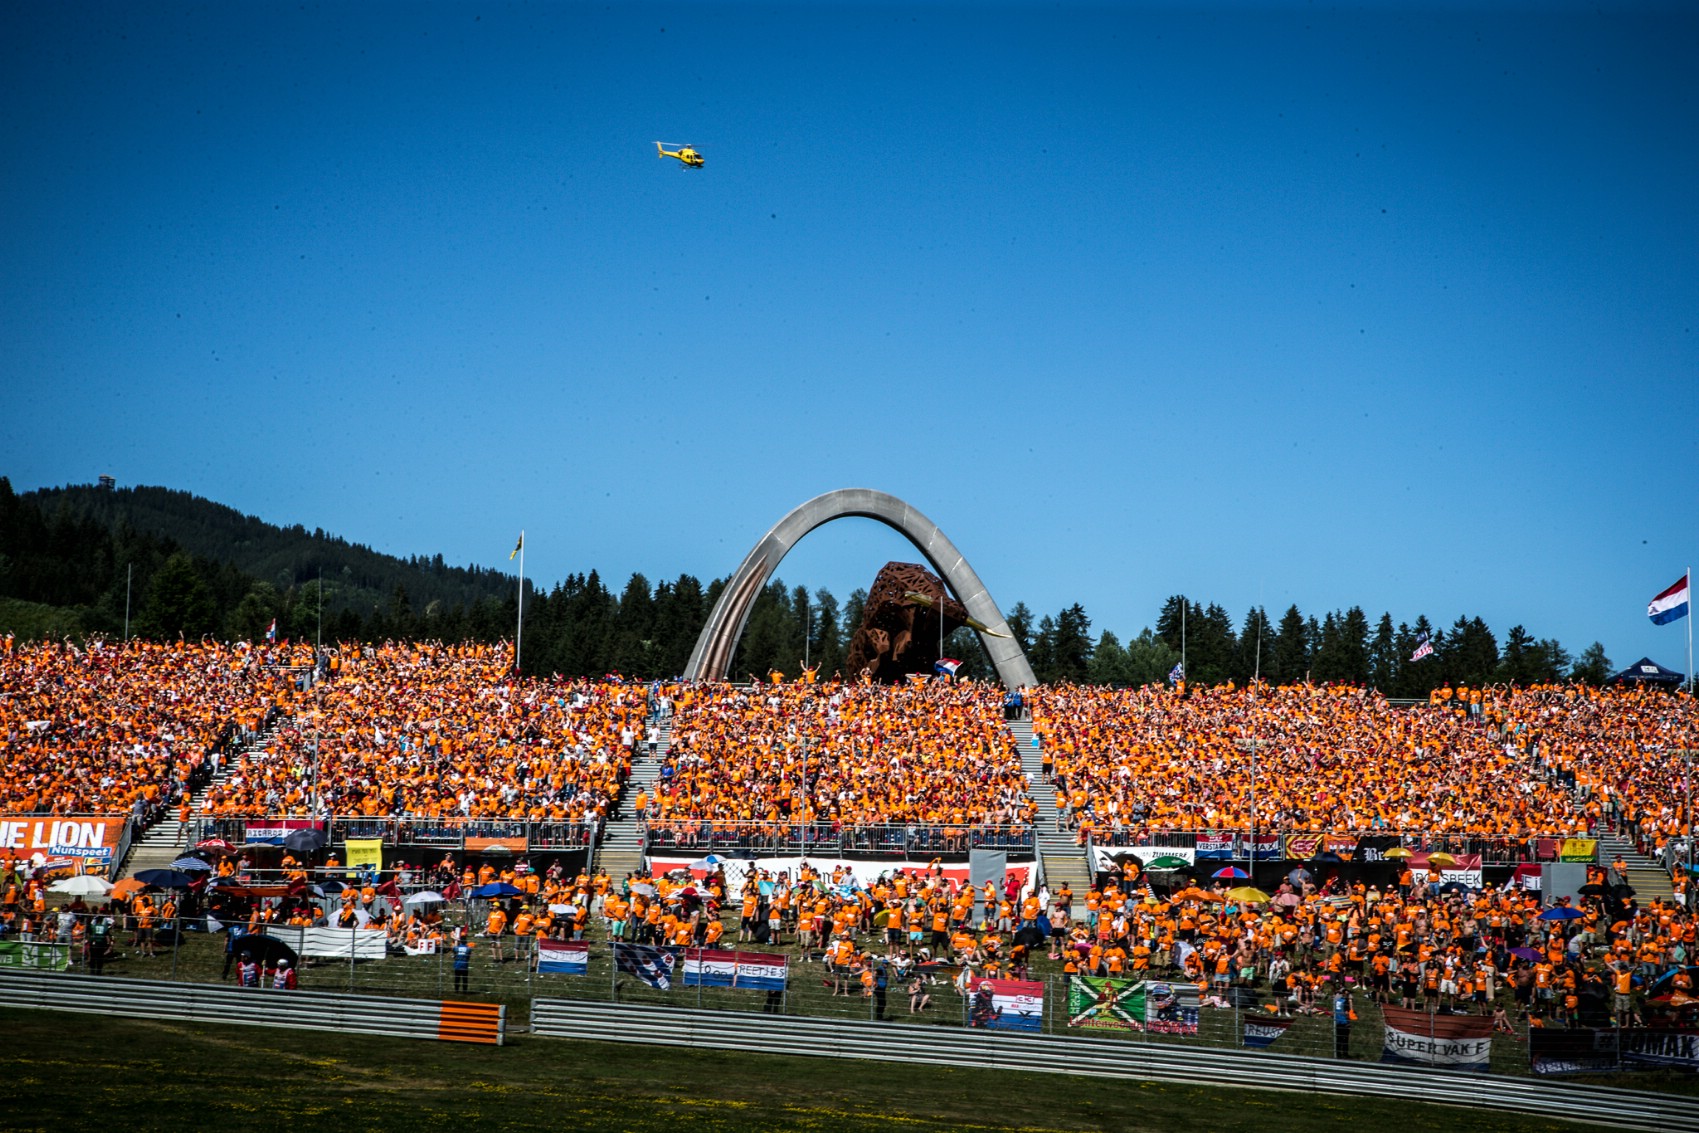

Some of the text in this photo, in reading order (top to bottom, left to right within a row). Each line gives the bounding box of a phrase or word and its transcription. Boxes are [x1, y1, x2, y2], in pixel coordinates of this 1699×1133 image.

[31, 821, 105, 848] LION
[51, 846, 108, 857] Nunspeet
[1387, 1031, 1485, 1056] SUPER VAK F
